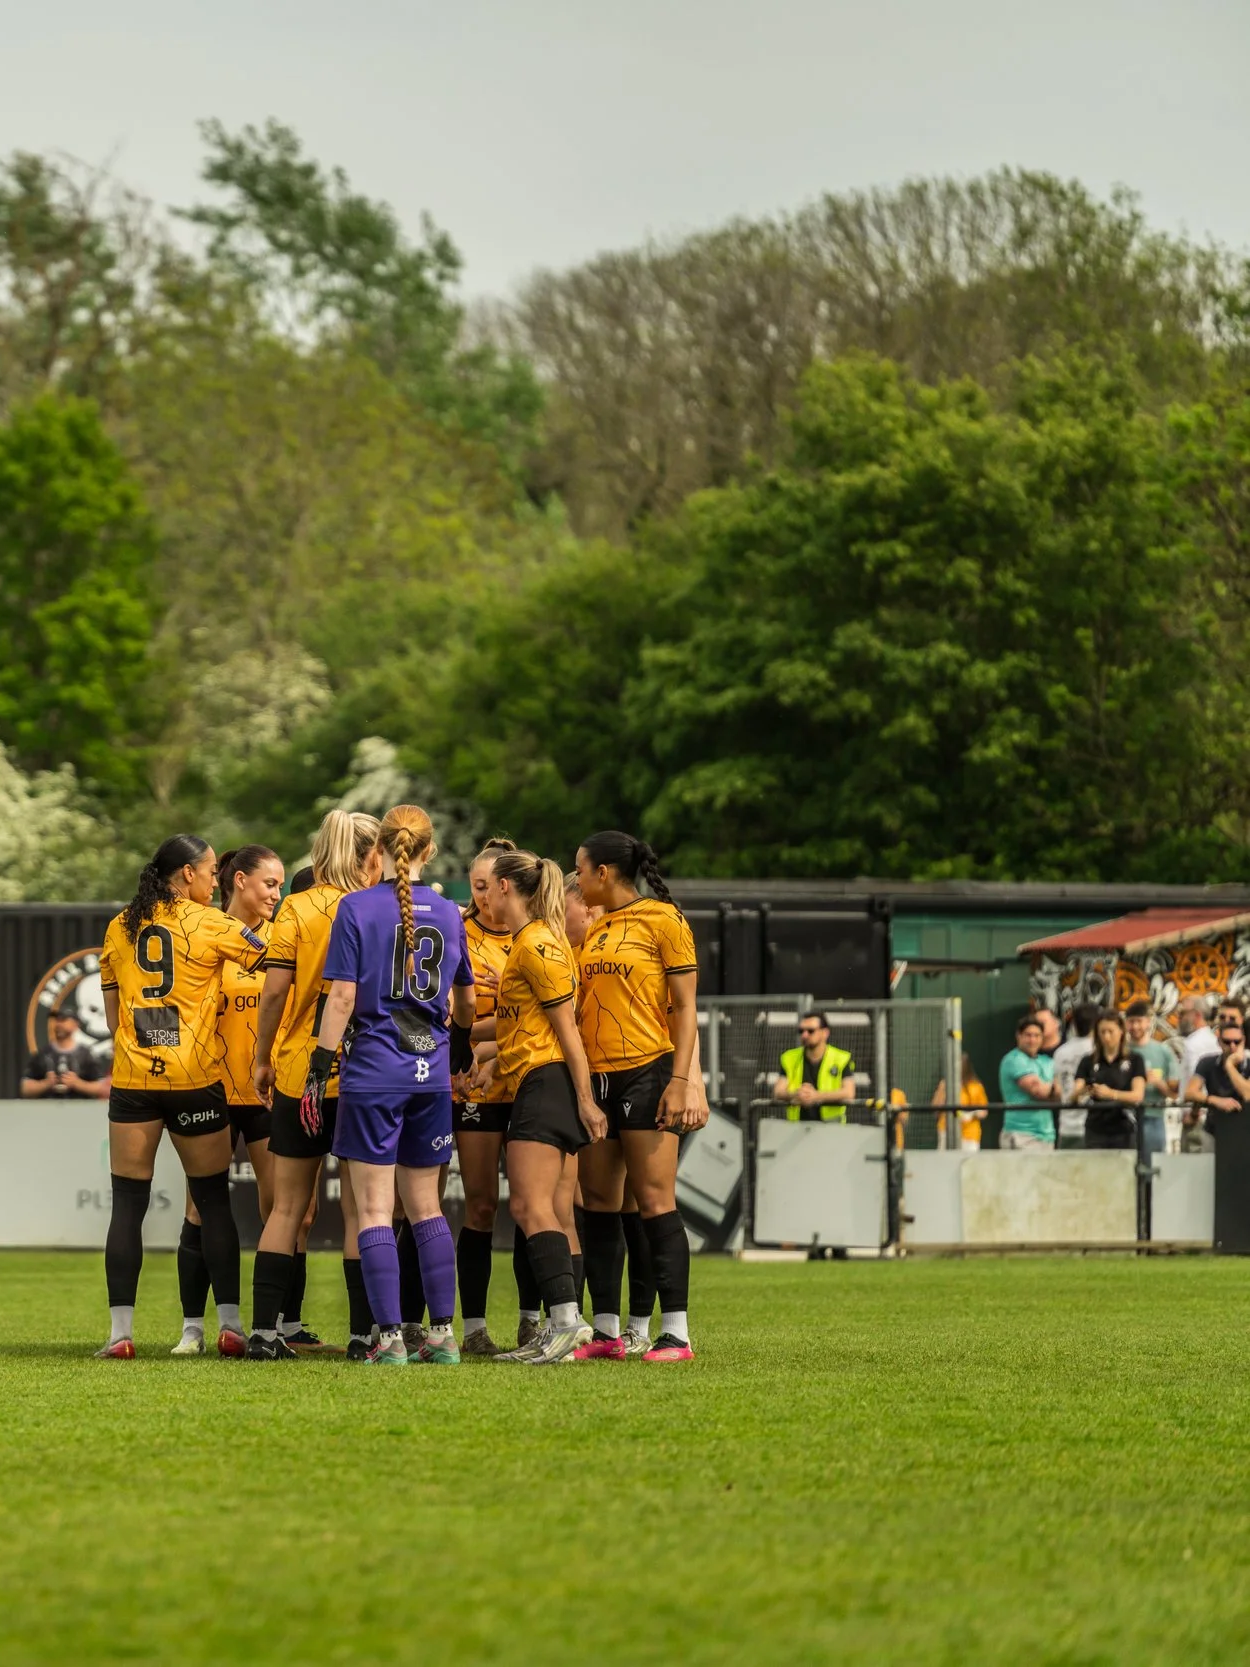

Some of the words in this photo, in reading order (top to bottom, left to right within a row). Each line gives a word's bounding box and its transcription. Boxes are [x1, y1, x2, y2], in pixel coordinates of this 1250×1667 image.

[136, 924, 174, 999] 9
[390, 923, 445, 1002] 13
[585, 958, 634, 980] galaxy
[235, 992, 260, 1012] gal
[497, 1005, 519, 1022] axy
[146, 1029, 178, 1039] STONE
[151, 1037, 179, 1046] RIDGE
[192, 1109, 214, 1124] PJH
